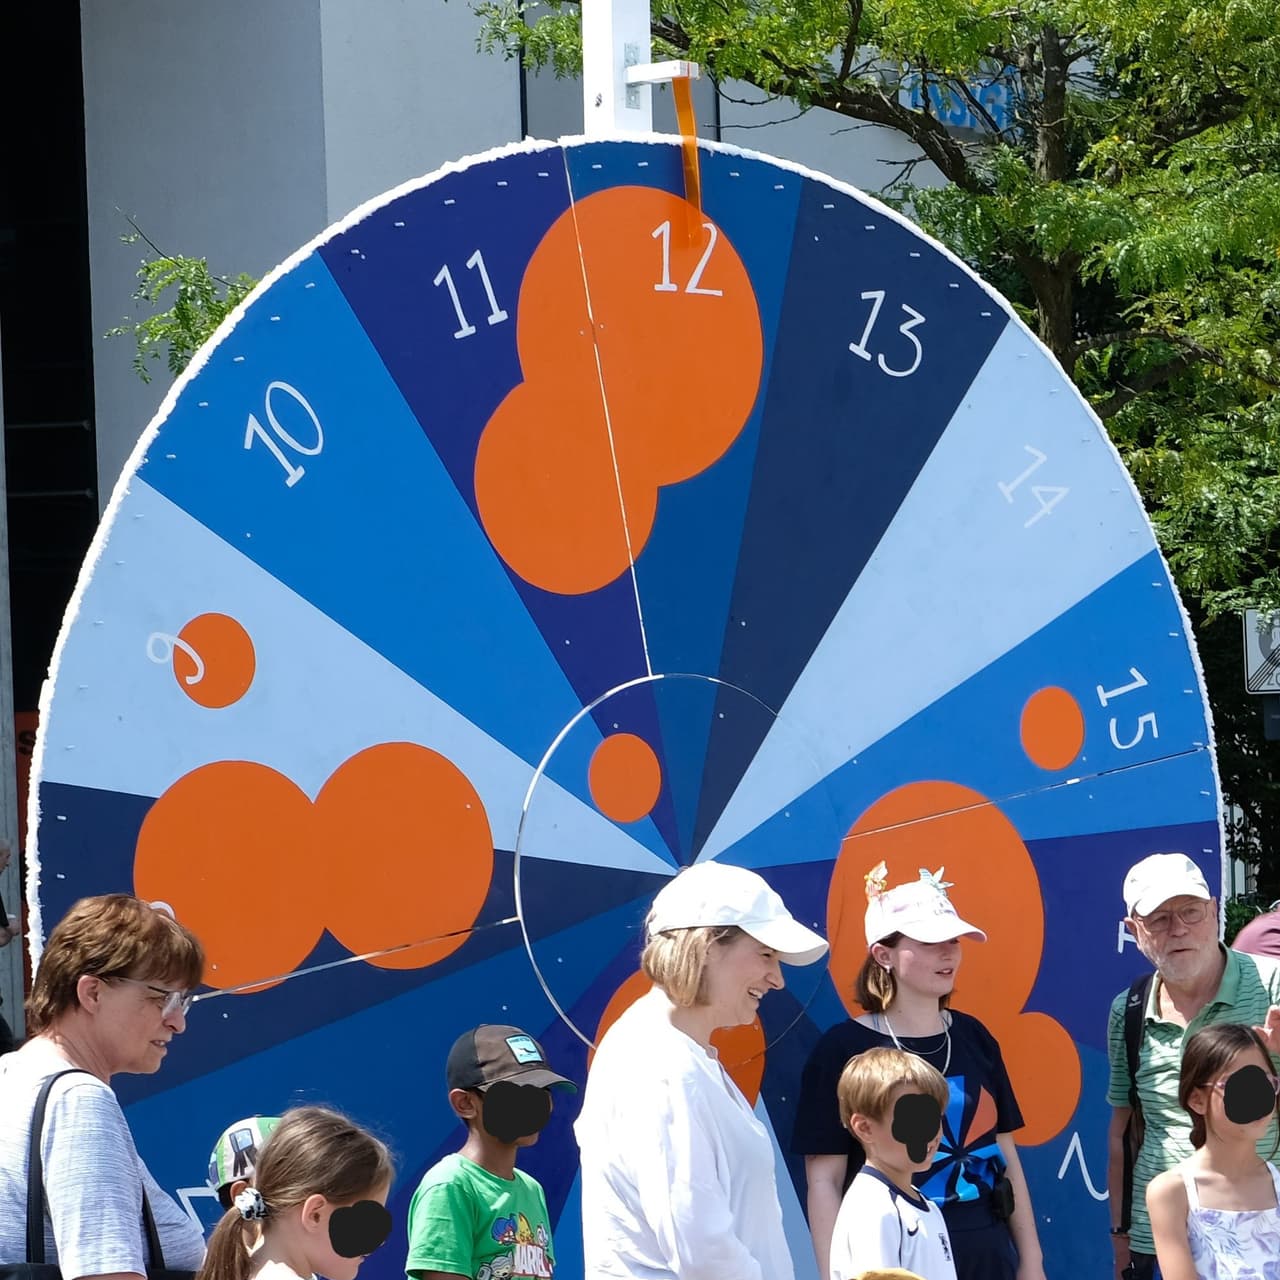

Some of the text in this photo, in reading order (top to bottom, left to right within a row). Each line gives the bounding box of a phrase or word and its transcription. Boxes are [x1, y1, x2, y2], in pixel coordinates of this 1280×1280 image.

[433, 249, 508, 339] 11
[651, 220, 723, 296] 12
[849, 290, 926, 376] 13
[244, 381, 324, 487] 10
[998, 444, 1070, 529] 14
[146, 631, 205, 686] 9
[1096, 667, 1160, 751] 15
